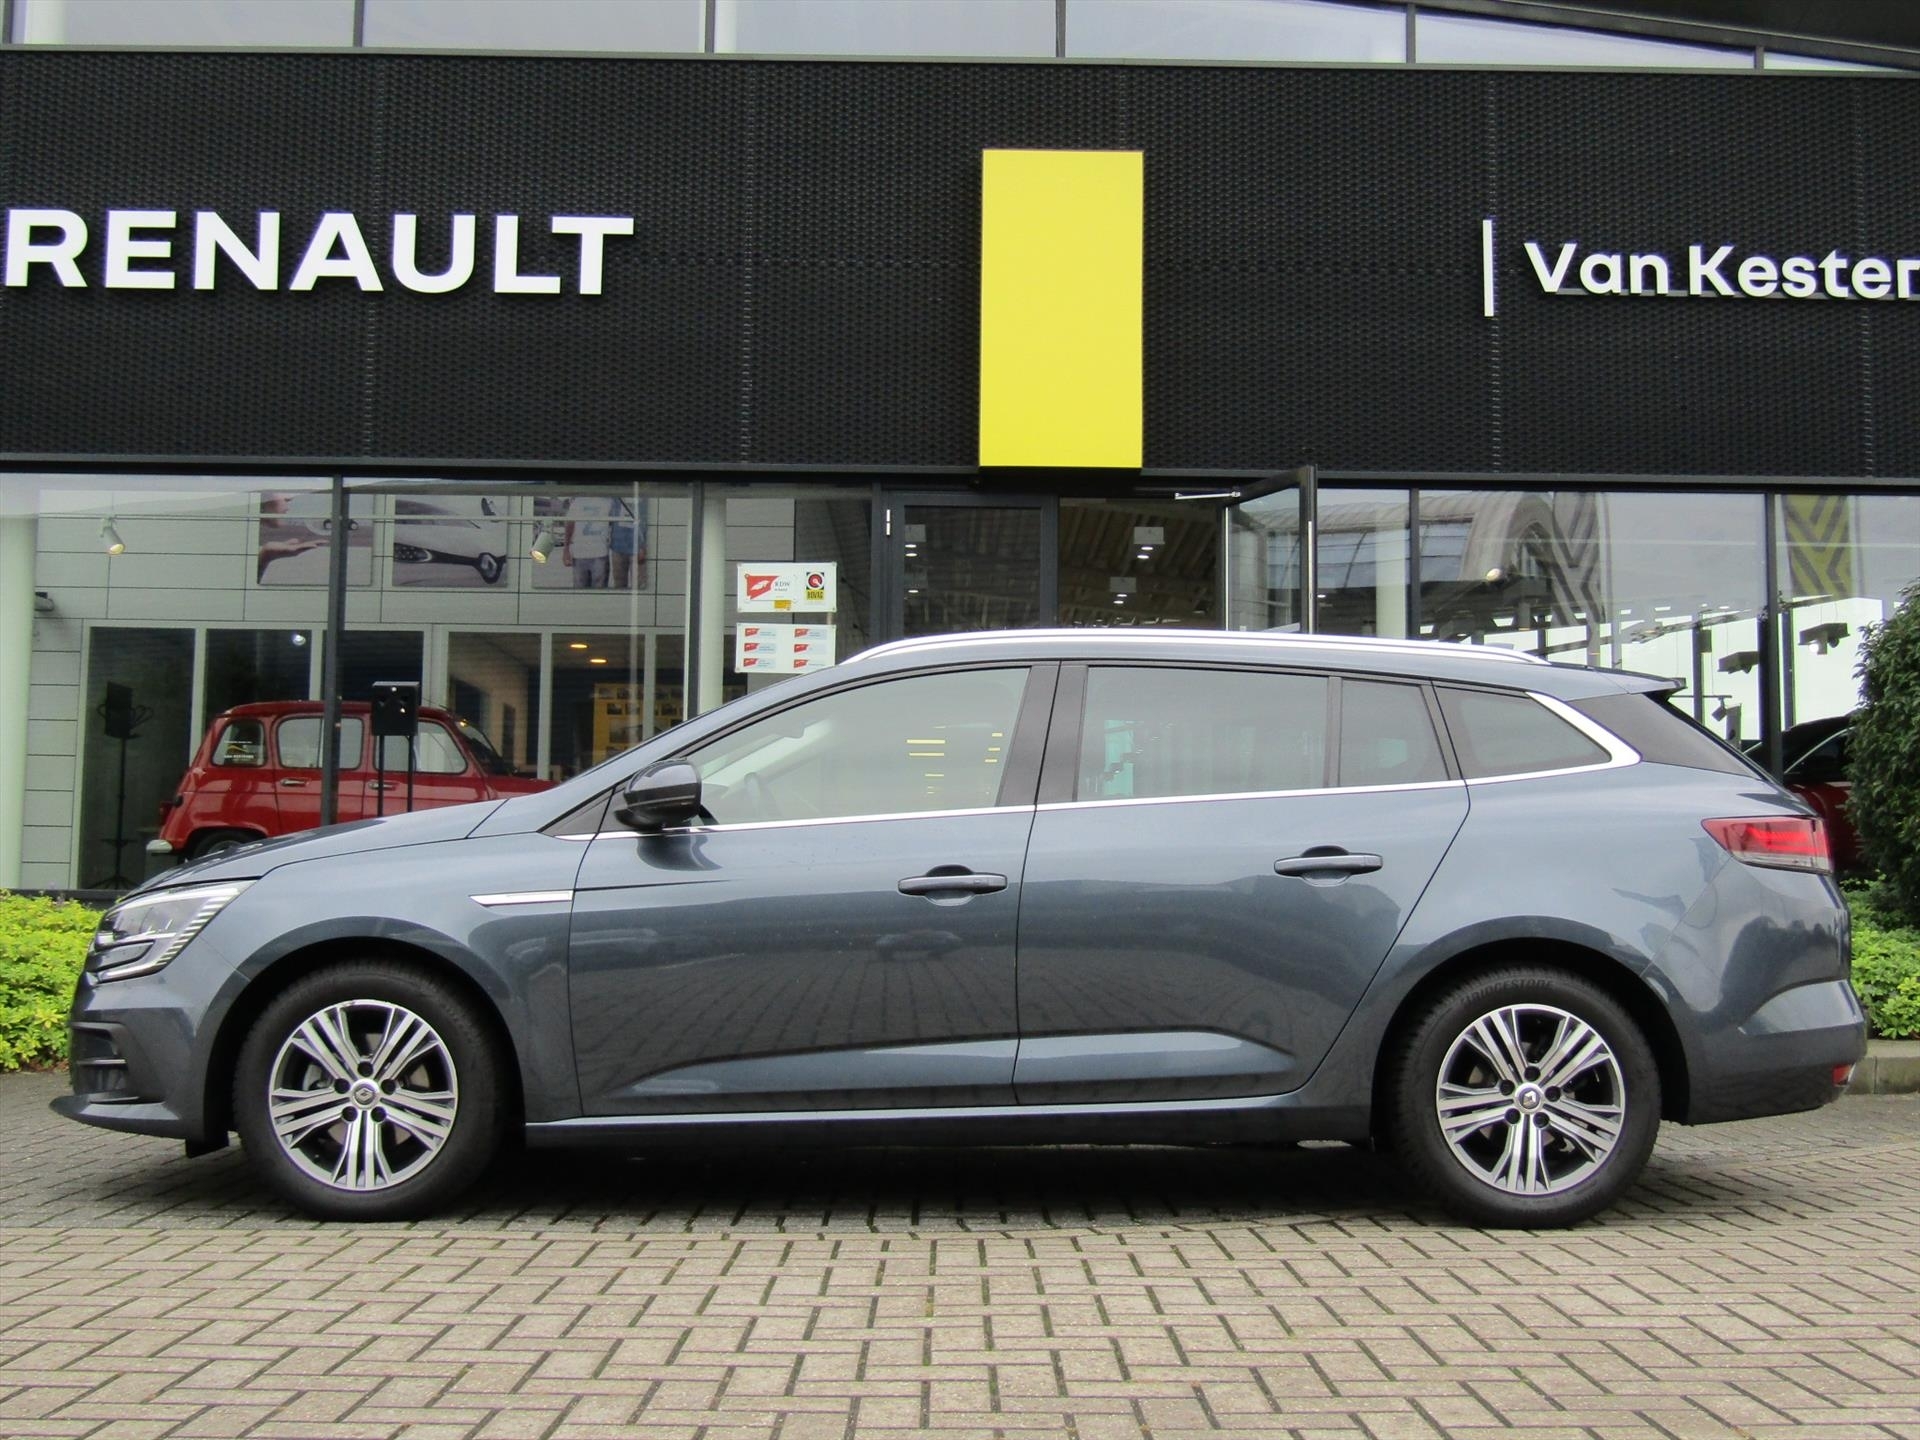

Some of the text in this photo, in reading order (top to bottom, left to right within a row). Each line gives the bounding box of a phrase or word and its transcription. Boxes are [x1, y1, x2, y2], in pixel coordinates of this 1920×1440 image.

[4, 208, 634, 296] RENAULT
[1524, 242, 1920, 298] Van Kester
